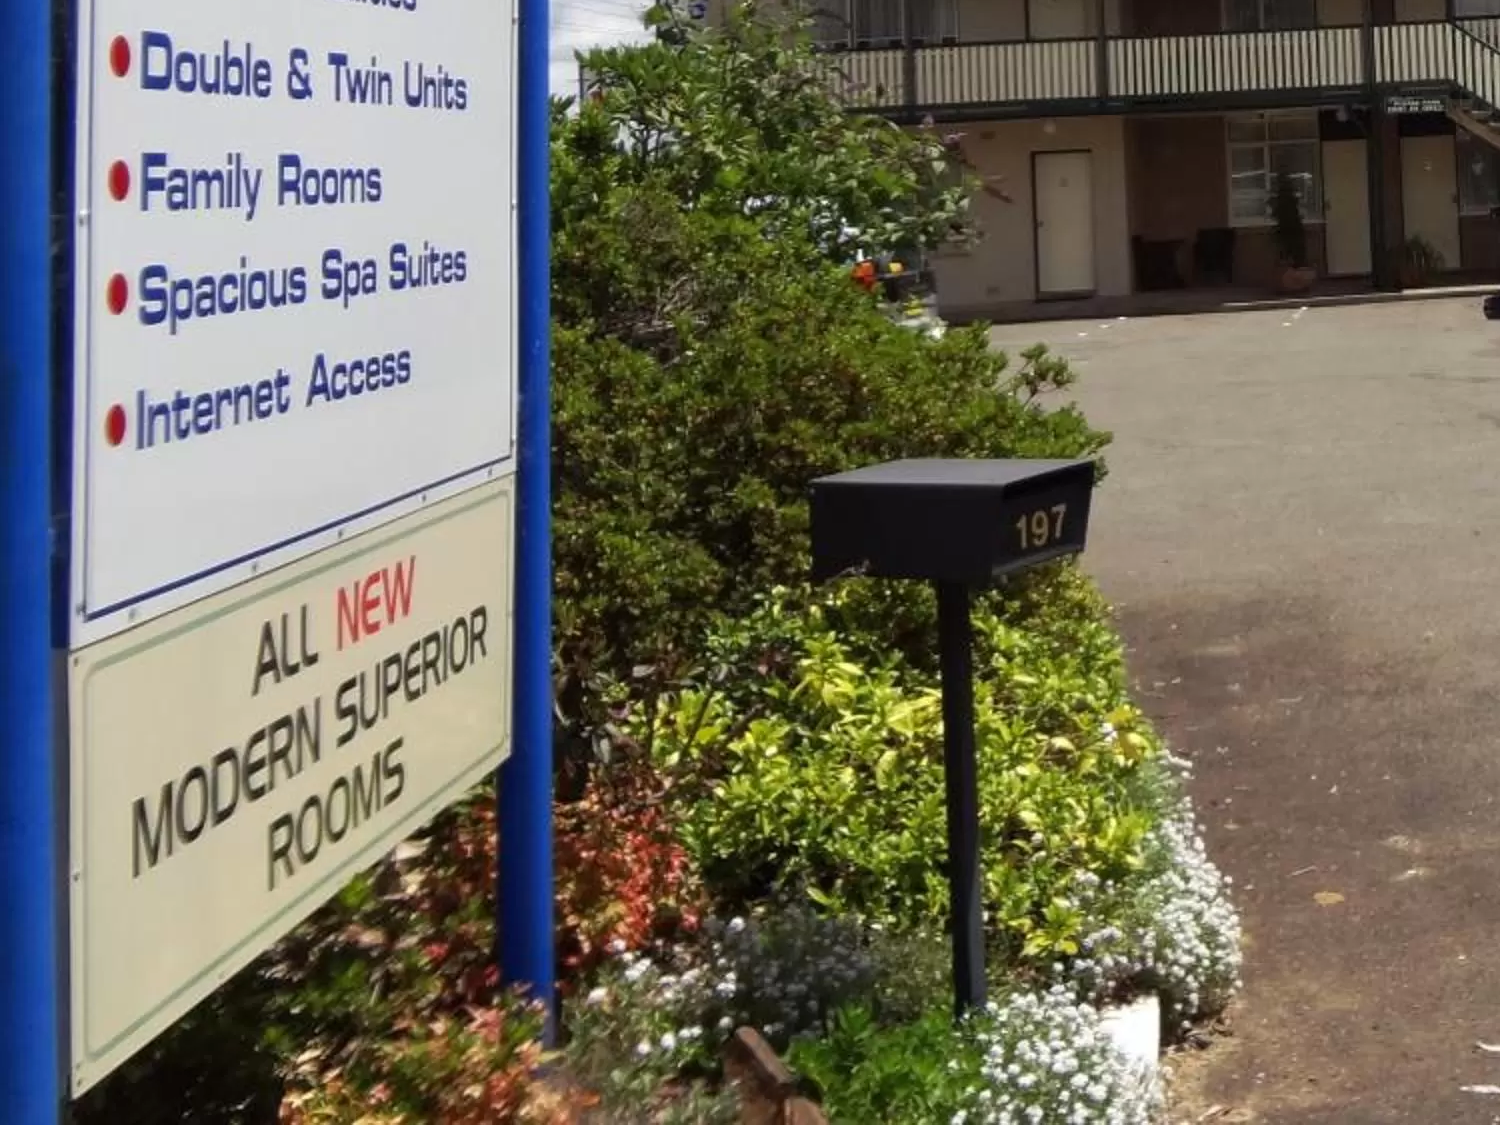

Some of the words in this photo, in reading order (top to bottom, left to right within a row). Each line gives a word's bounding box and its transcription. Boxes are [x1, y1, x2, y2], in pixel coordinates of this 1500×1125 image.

[140, 30, 272, 98] Double
[287, 48, 313, 100] &
[327, 52, 393, 106] Twin
[404, 61, 468, 111] Units
[140, 152, 263, 222] Family
[277, 153, 382, 206] Rooms
[138, 255, 307, 336] Spacious
[321, 248, 377, 310] Spa
[389, 240, 467, 291] Suites
[135, 368, 291, 450] Internet
[305, 350, 411, 408] Access
[1015, 503, 1068, 550] 197
[251, 604, 320, 697] ALL
[336, 555, 416, 652] NEW
[131, 696, 321, 879] MODERN
[334, 604, 488, 749] SUPERIOR
[266, 736, 406, 892] ROOMS
